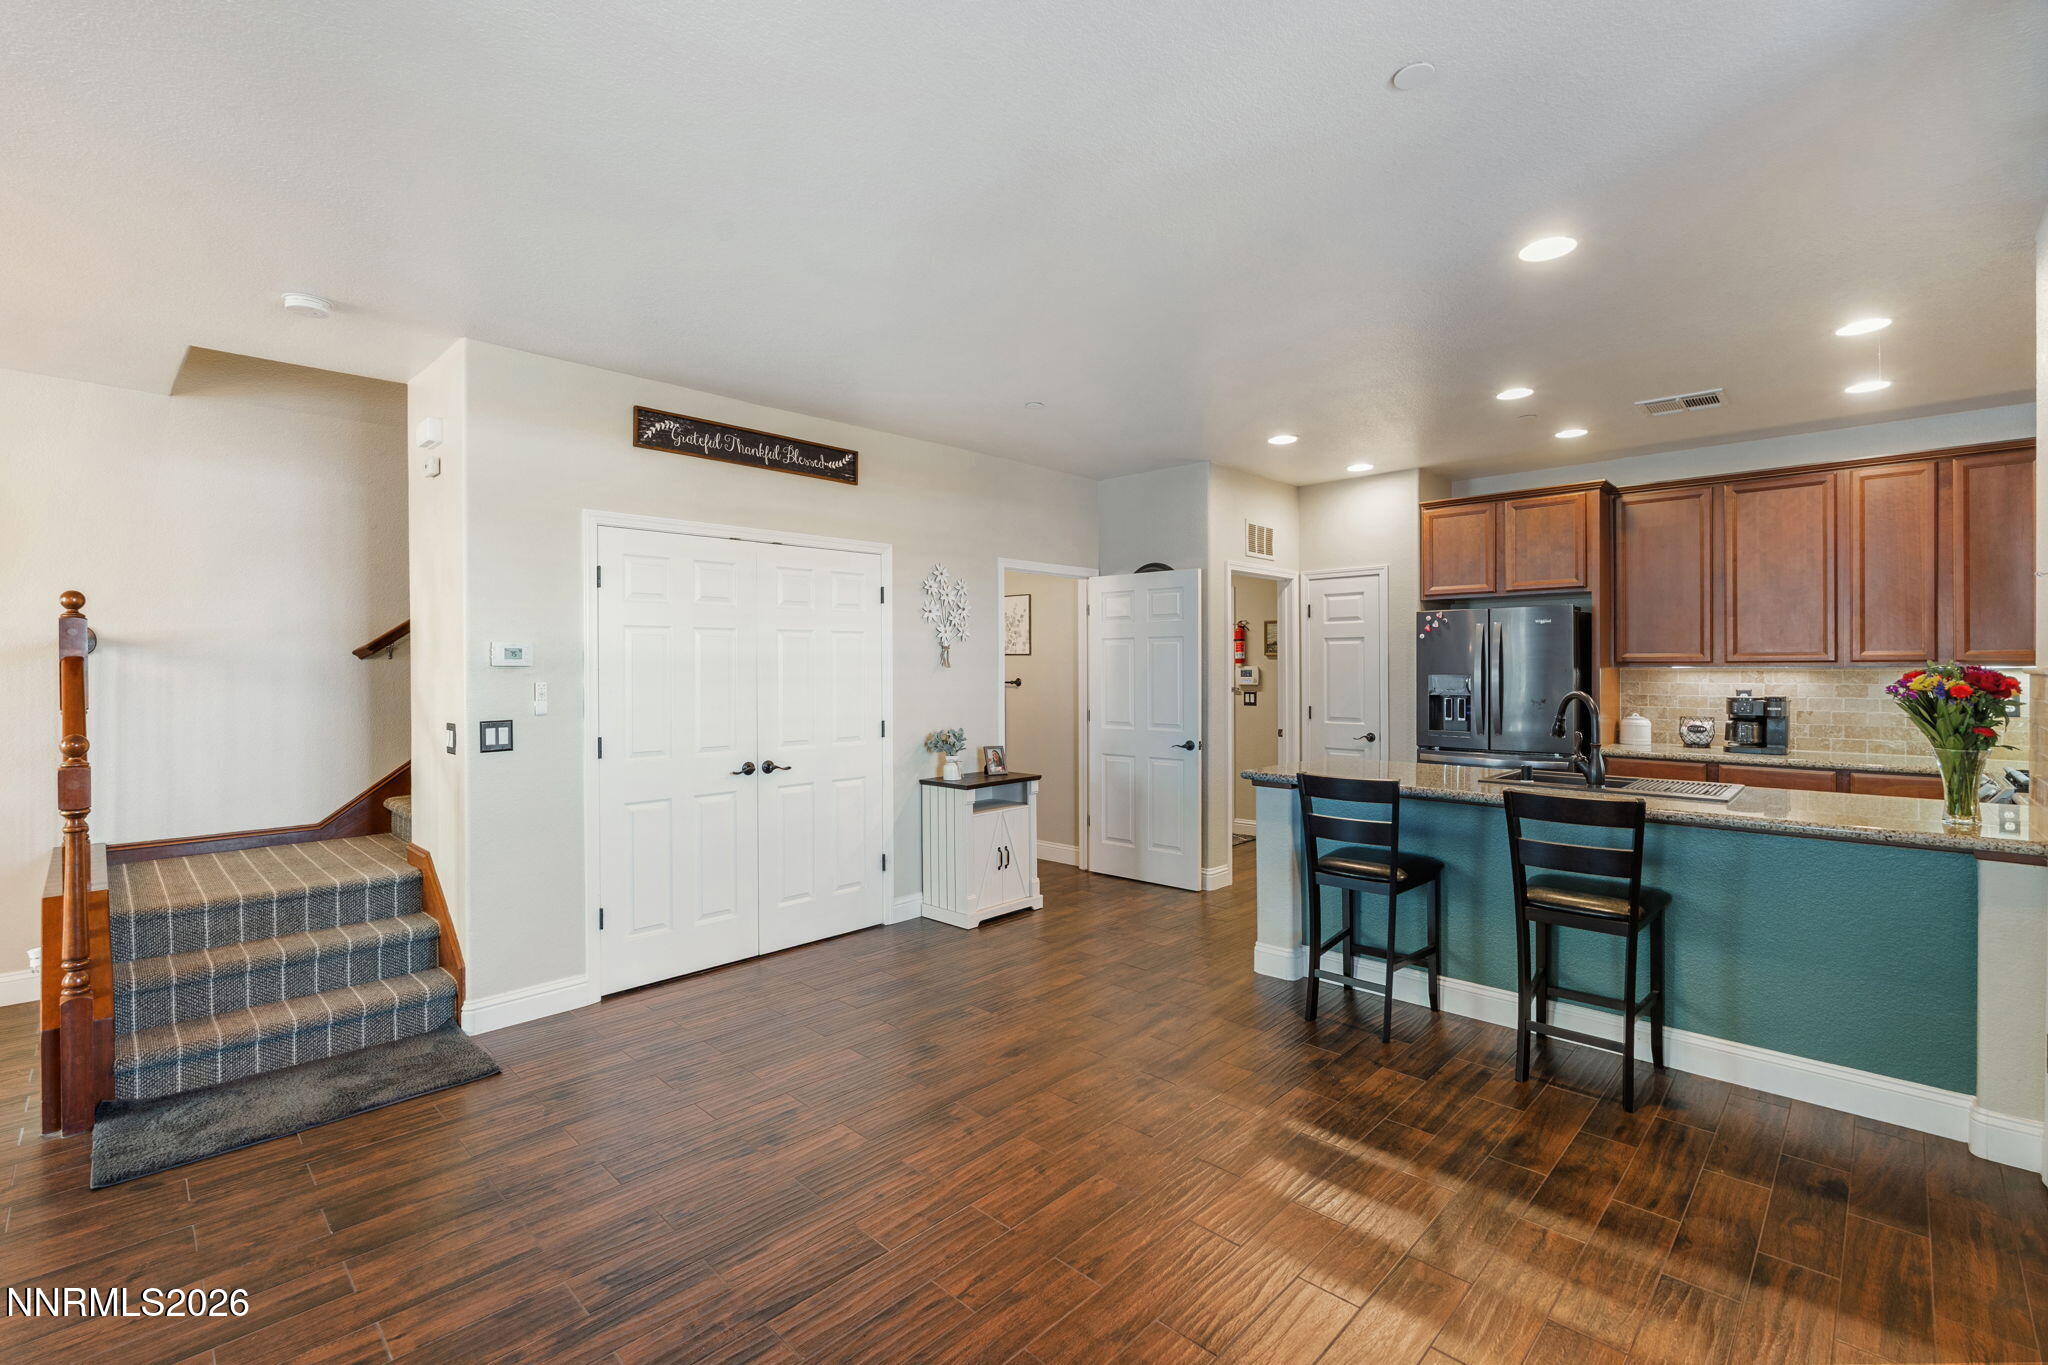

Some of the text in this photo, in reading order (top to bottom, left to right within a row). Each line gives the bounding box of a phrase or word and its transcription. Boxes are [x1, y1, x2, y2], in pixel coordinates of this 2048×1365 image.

[671, 424, 825, 469] Grateful Thankful Blessed
